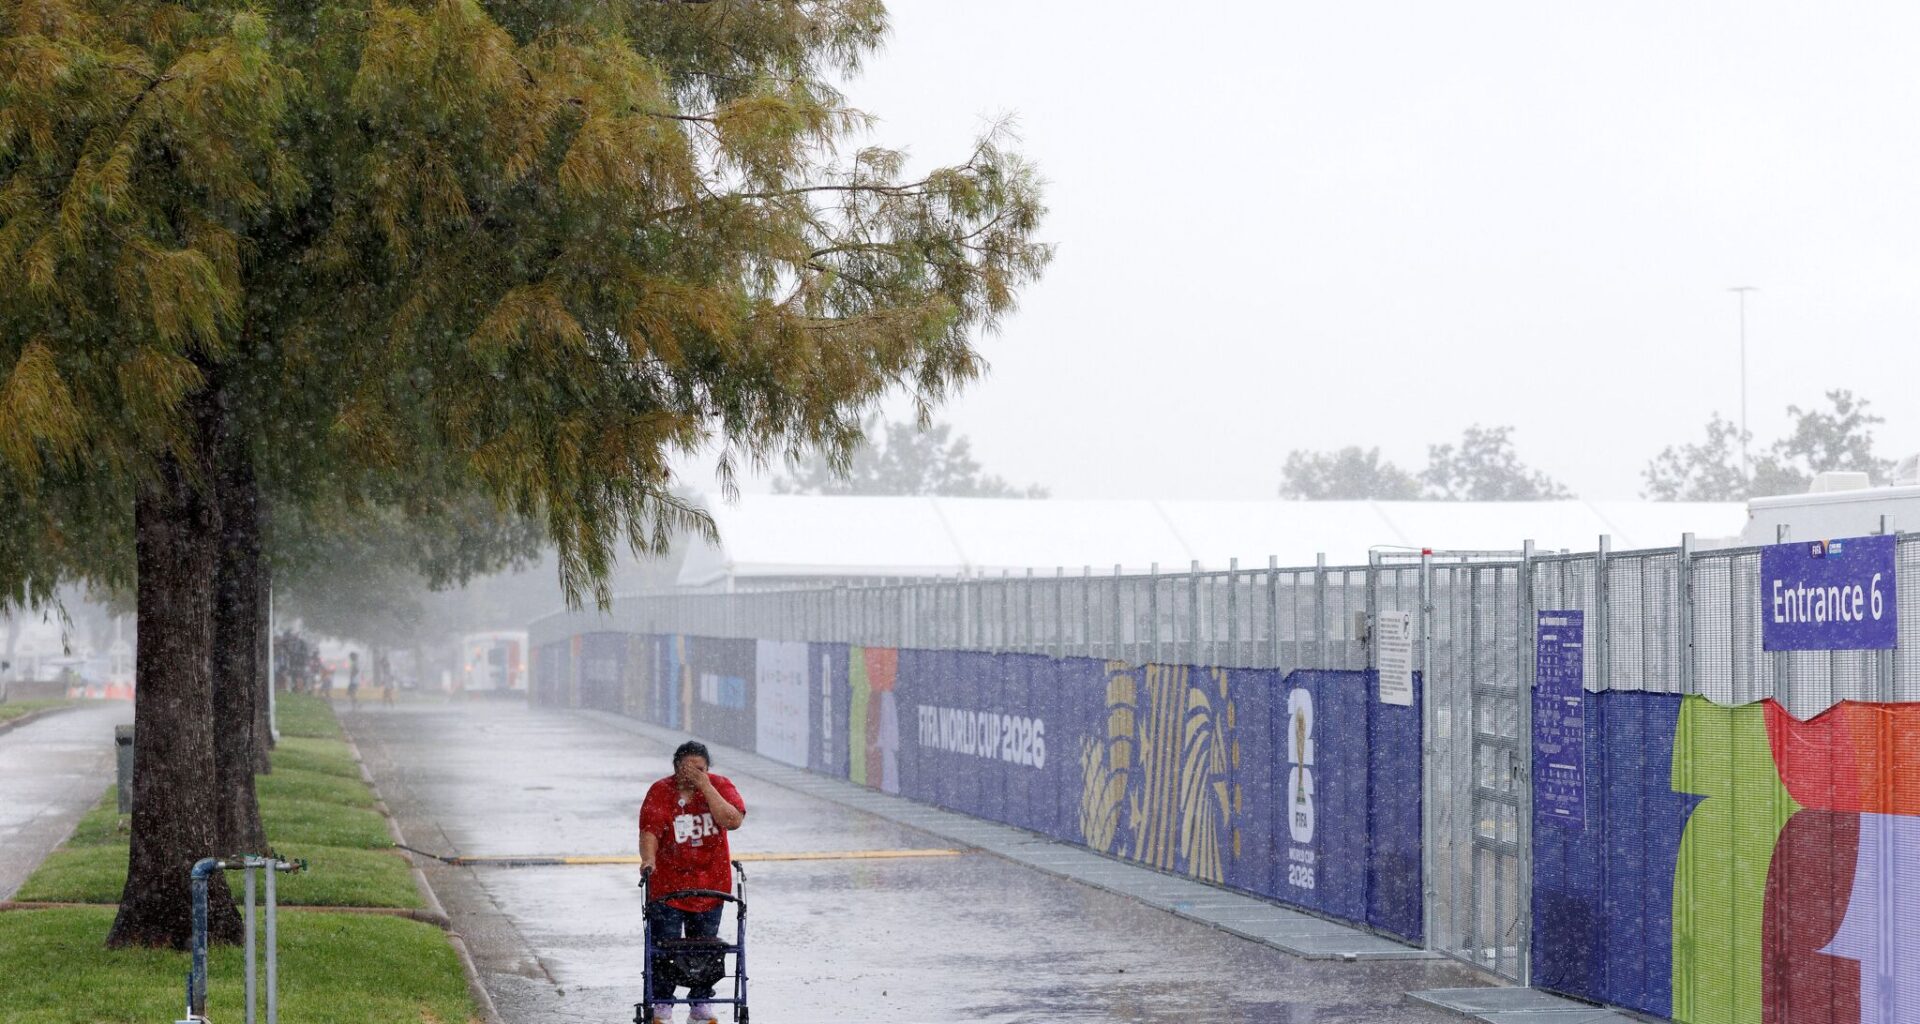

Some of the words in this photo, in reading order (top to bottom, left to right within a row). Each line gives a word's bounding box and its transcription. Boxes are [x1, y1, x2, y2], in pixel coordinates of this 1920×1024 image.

[1773, 579, 1864, 623] Entrance
[1870, 572, 1882, 620] 6
[919, 705, 940, 749] FIFA
[940, 707, 977, 755] WORLD
[978, 711, 1001, 759] CUP
[1002, 714, 1046, 770] 2026
[1296, 812, 1308, 829] FIFA
[1289, 848, 1304, 862] WORLD
[1305, 850, 1314, 864] CUP
[1288, 864, 1315, 889] 2026
